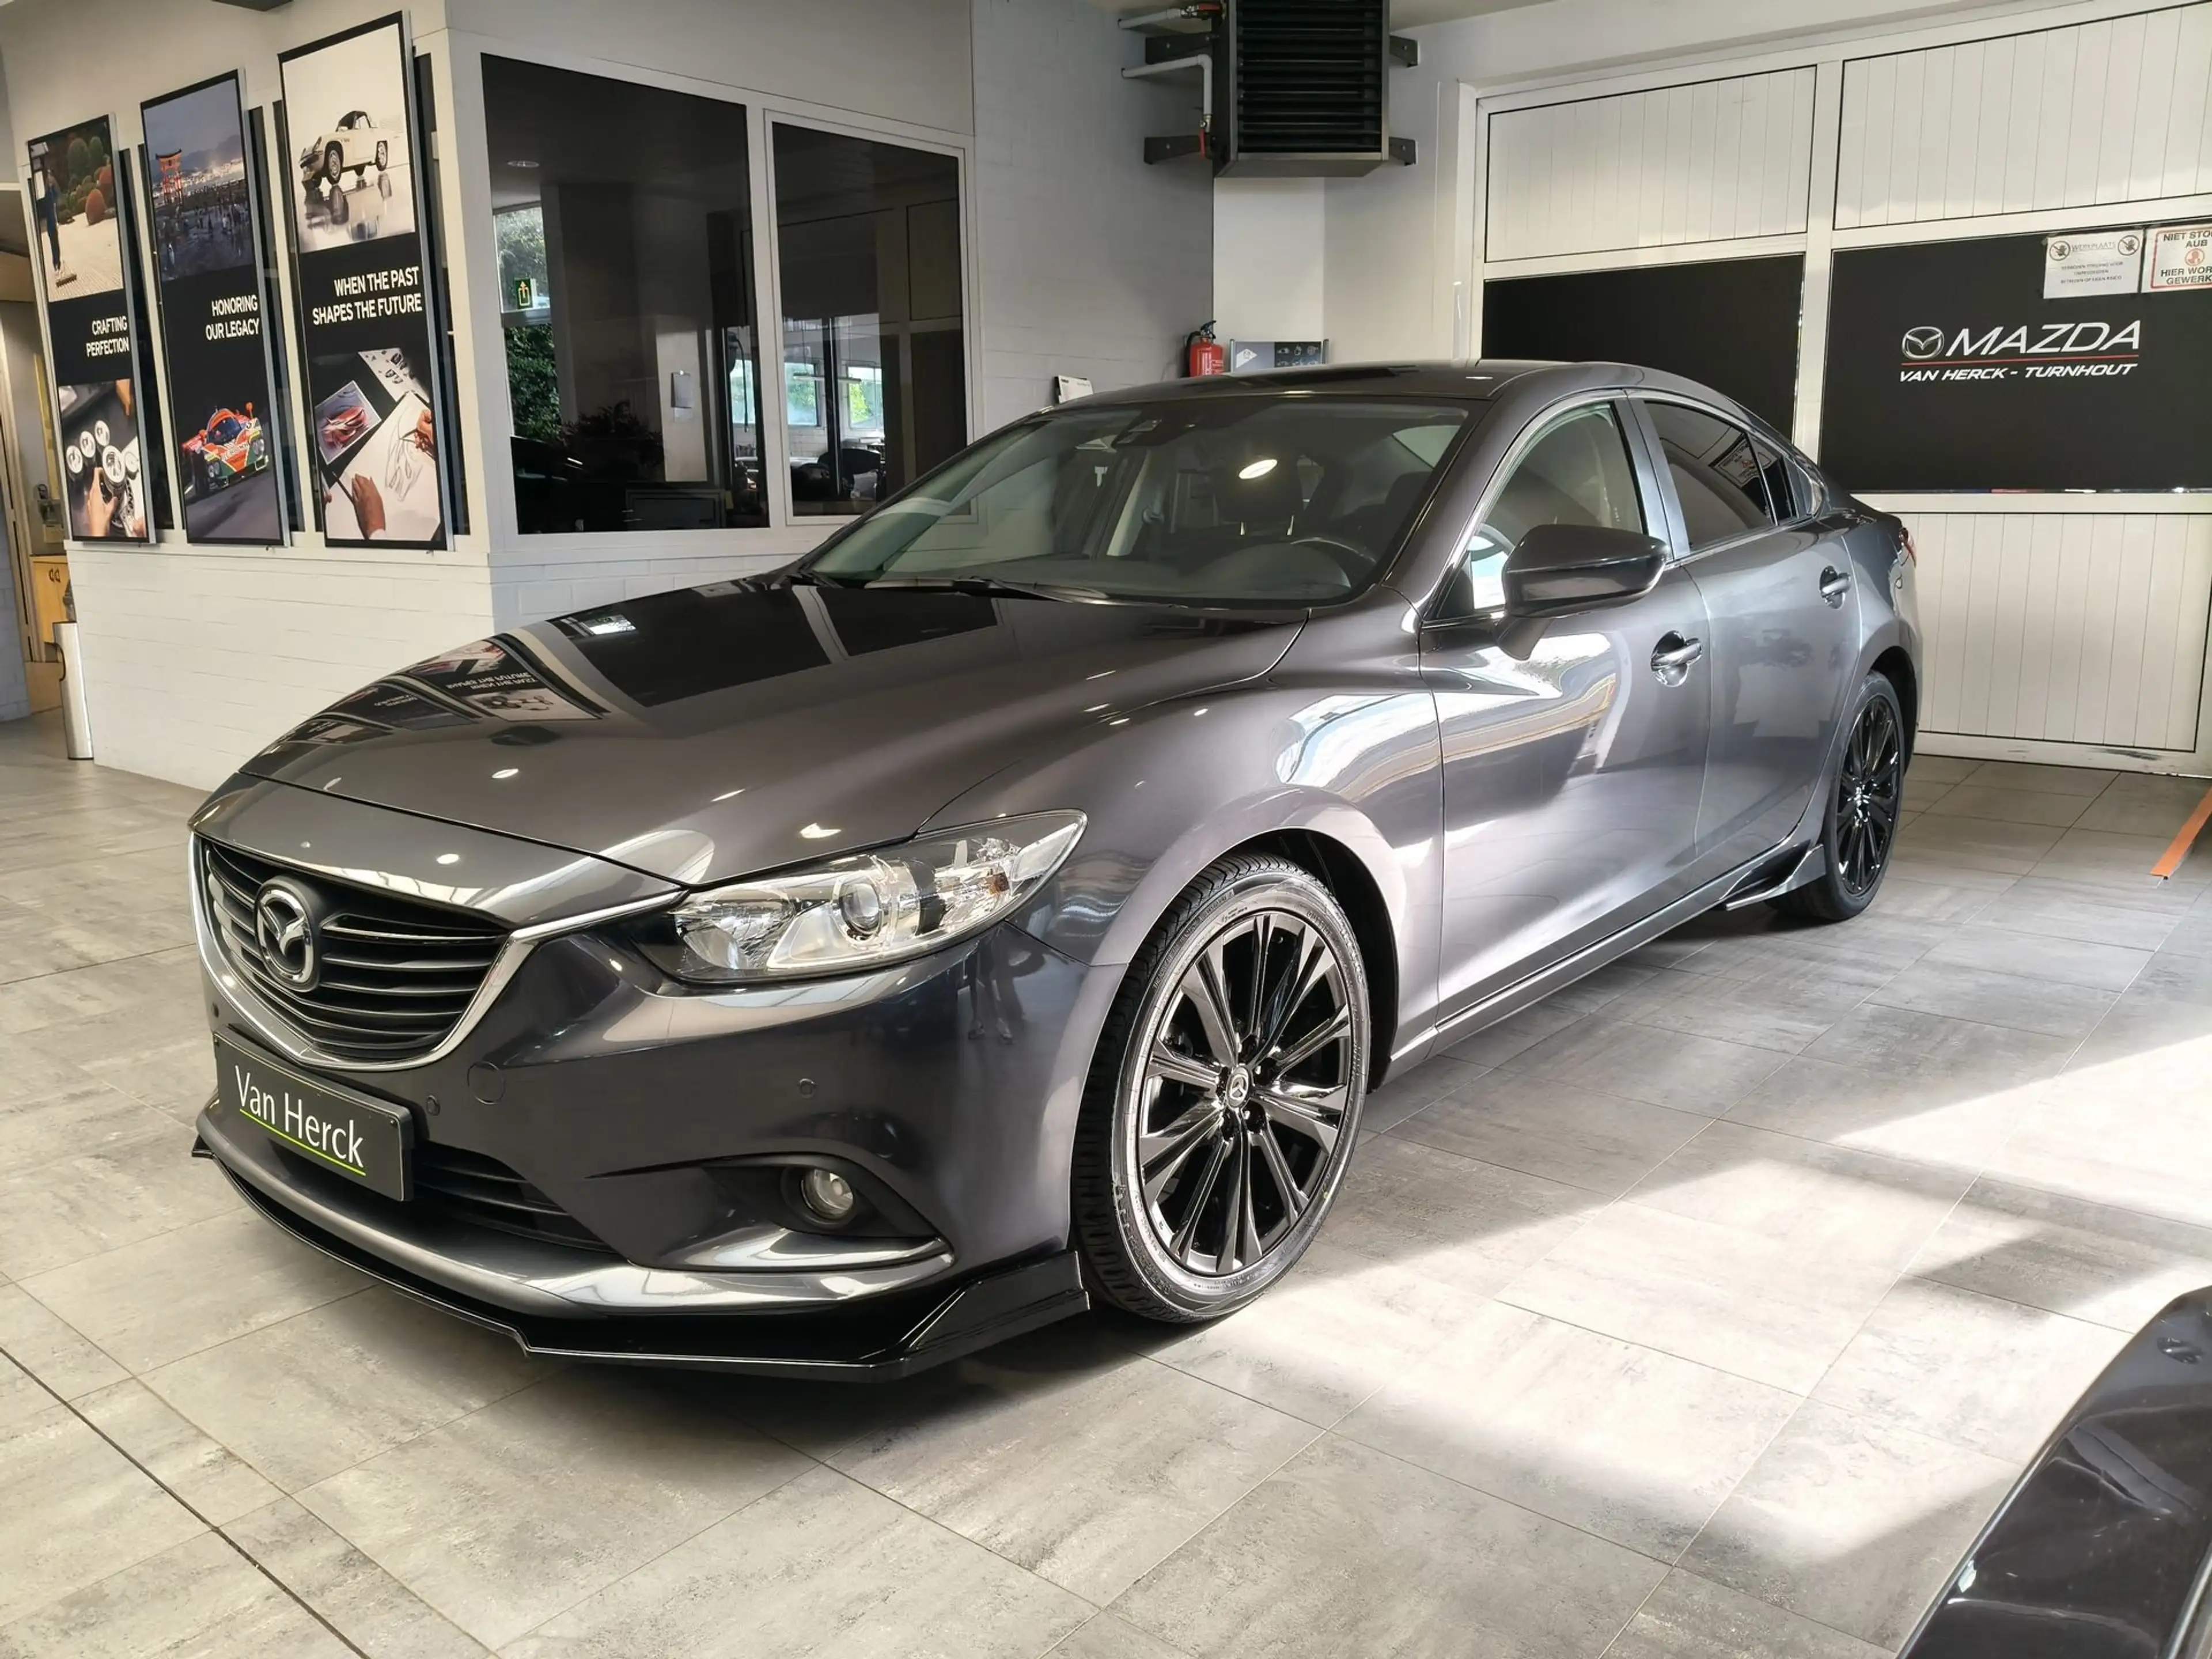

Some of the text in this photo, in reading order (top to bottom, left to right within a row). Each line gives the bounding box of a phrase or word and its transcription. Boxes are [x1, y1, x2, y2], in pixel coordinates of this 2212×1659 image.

[2164, 230, 2212, 241] NIET STO
[2186, 239, 2208, 248] AUB
[334, 266, 419, 297] WHEN THE PAST
[2161, 268, 2184, 277] HIER
[211, 294, 258, 316] HONORING
[312, 293, 423, 325] SHAPES THE FUTURE
[92, 315, 128, 335] CRAFTING
[205, 317, 260, 340] OUR LEGACY
[85, 336, 130, 358] PERFECTION
[1945, 319, 2141, 357] MAZDA
[1899, 370, 1942, 382] VAN
[2024, 362, 2138, 378] TURNHOUT
[234, 1064, 364, 1169] Van Herck
